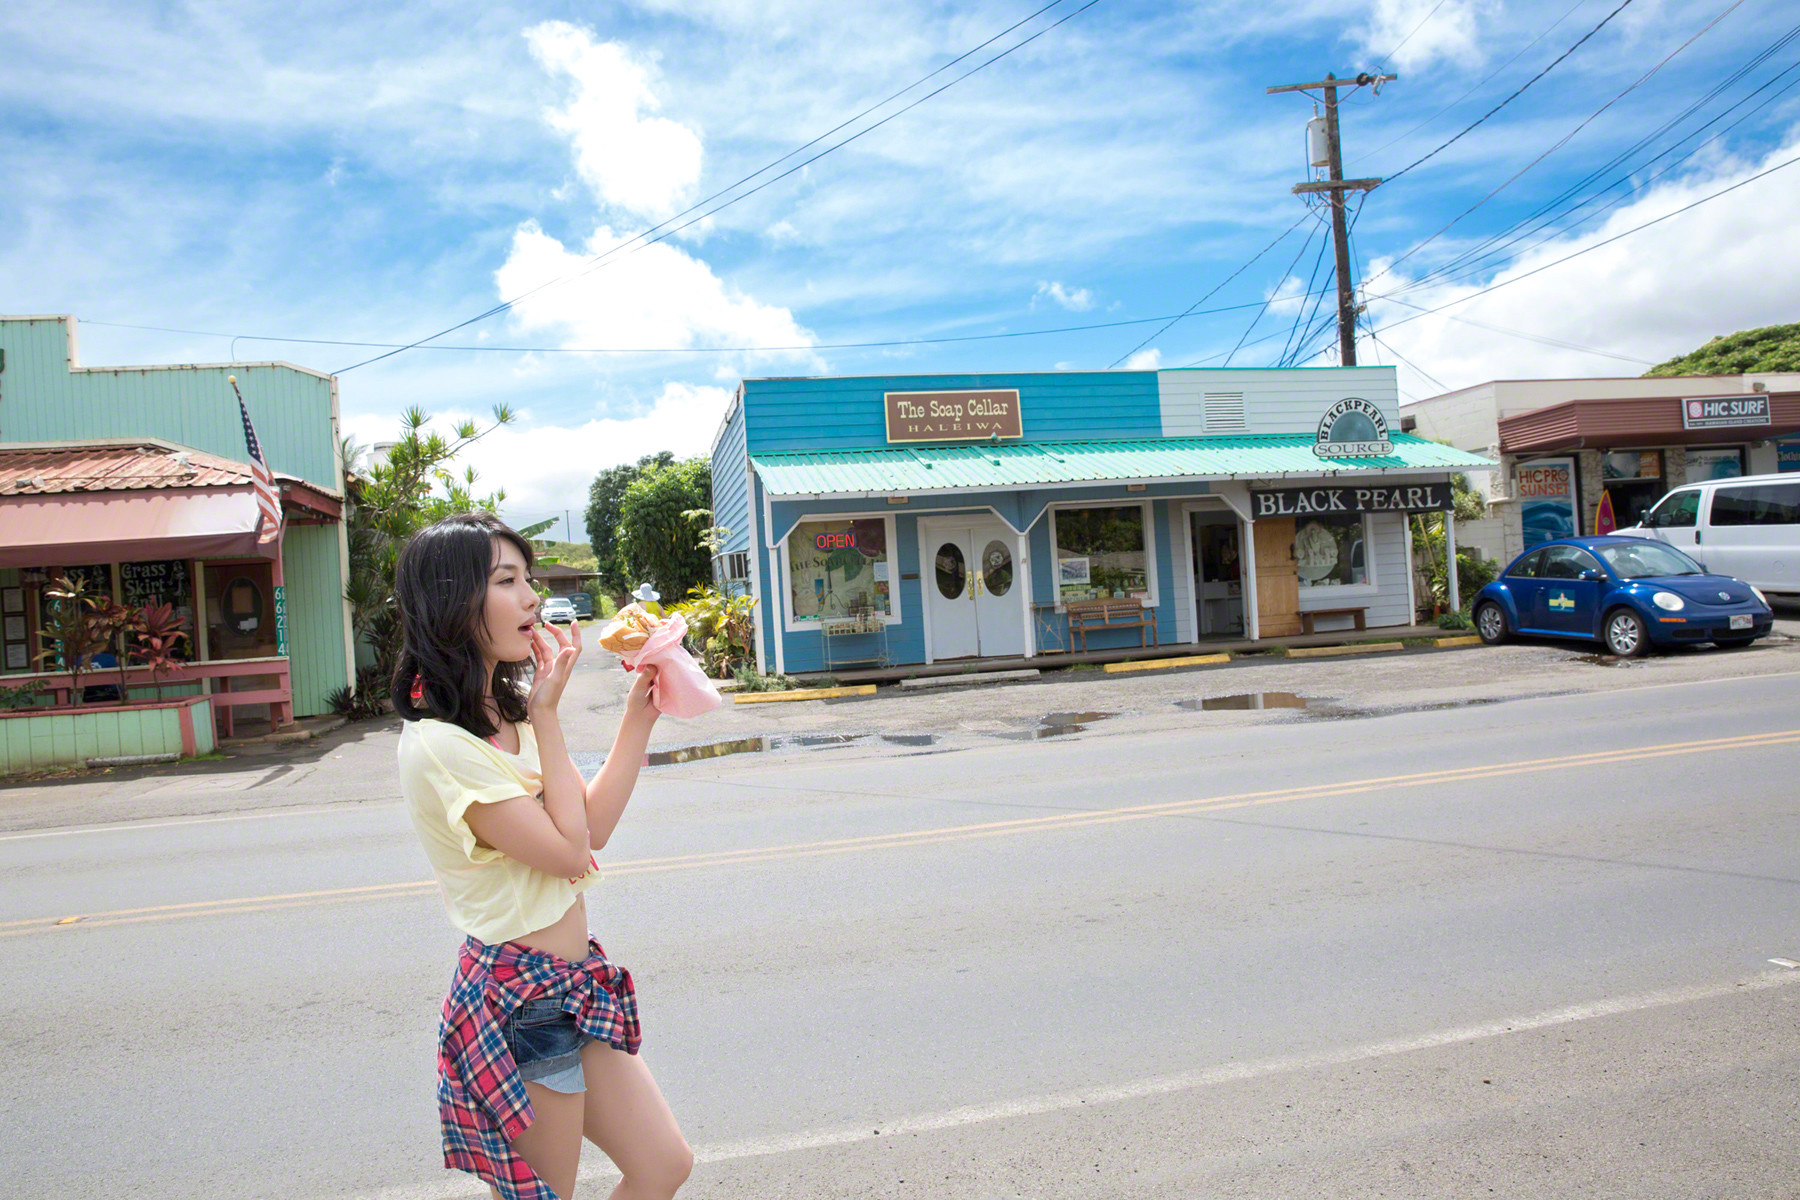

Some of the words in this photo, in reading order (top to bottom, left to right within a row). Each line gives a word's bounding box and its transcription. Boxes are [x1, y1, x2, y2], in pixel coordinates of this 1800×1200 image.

[897, 401, 926, 419] The
[930, 400, 963, 422] Soap
[967, 398, 1009, 416] Cellar
[1703, 402, 1729, 417] HIC
[1729, 400, 1765, 416] SURF
[908, 421, 1003, 433] HALEIWA
[1318, 442, 1392, 455] SOURCE
[1520, 482, 1569, 497] SUNSET
[1257, 489, 1347, 516] BLACK
[1354, 486, 1442, 511] PEARL
[816, 533, 856, 549] OPEN
[121, 563, 167, 580] Grass
[125, 578, 166, 597] Skirt
